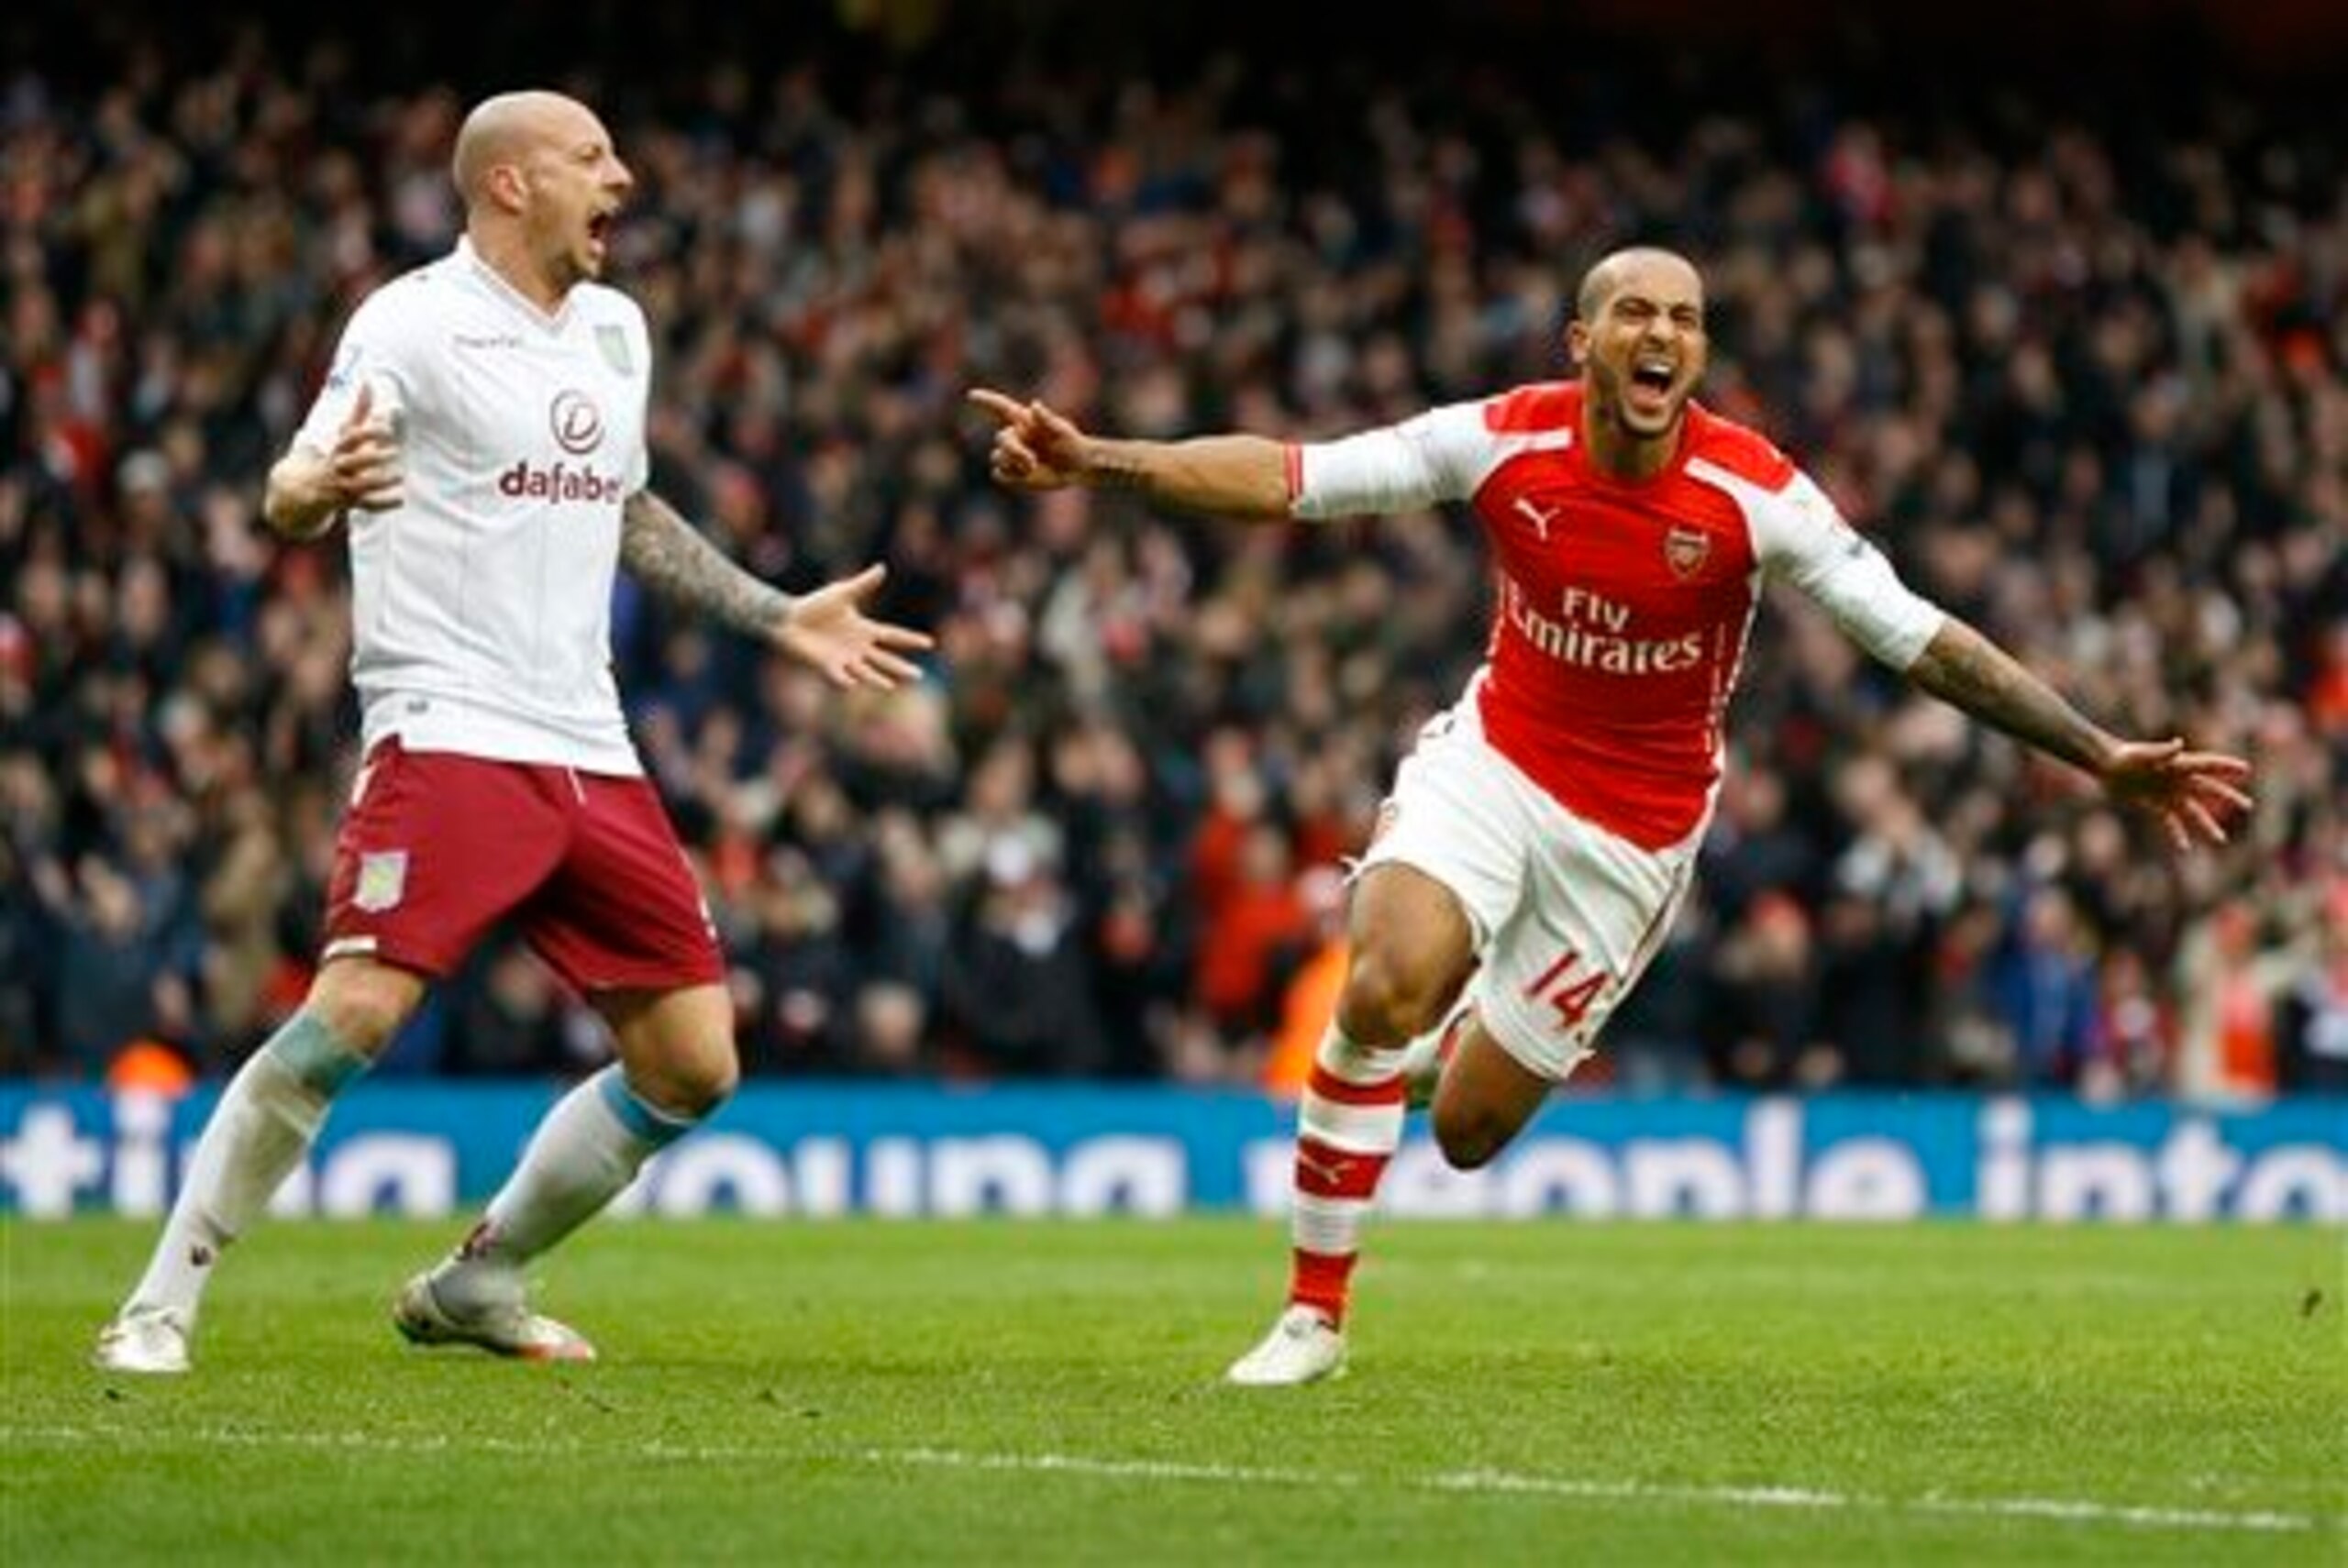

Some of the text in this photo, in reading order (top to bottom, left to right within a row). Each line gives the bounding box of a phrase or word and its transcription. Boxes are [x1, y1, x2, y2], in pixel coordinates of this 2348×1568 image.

[499, 458, 624, 503] dafabe
[1562, 587, 1630, 633] Fly
[1524, 950, 1610, 1030] 14
[601, 1132, 1185, 1221] oung
[1974, 1096, 2348, 1221] into
